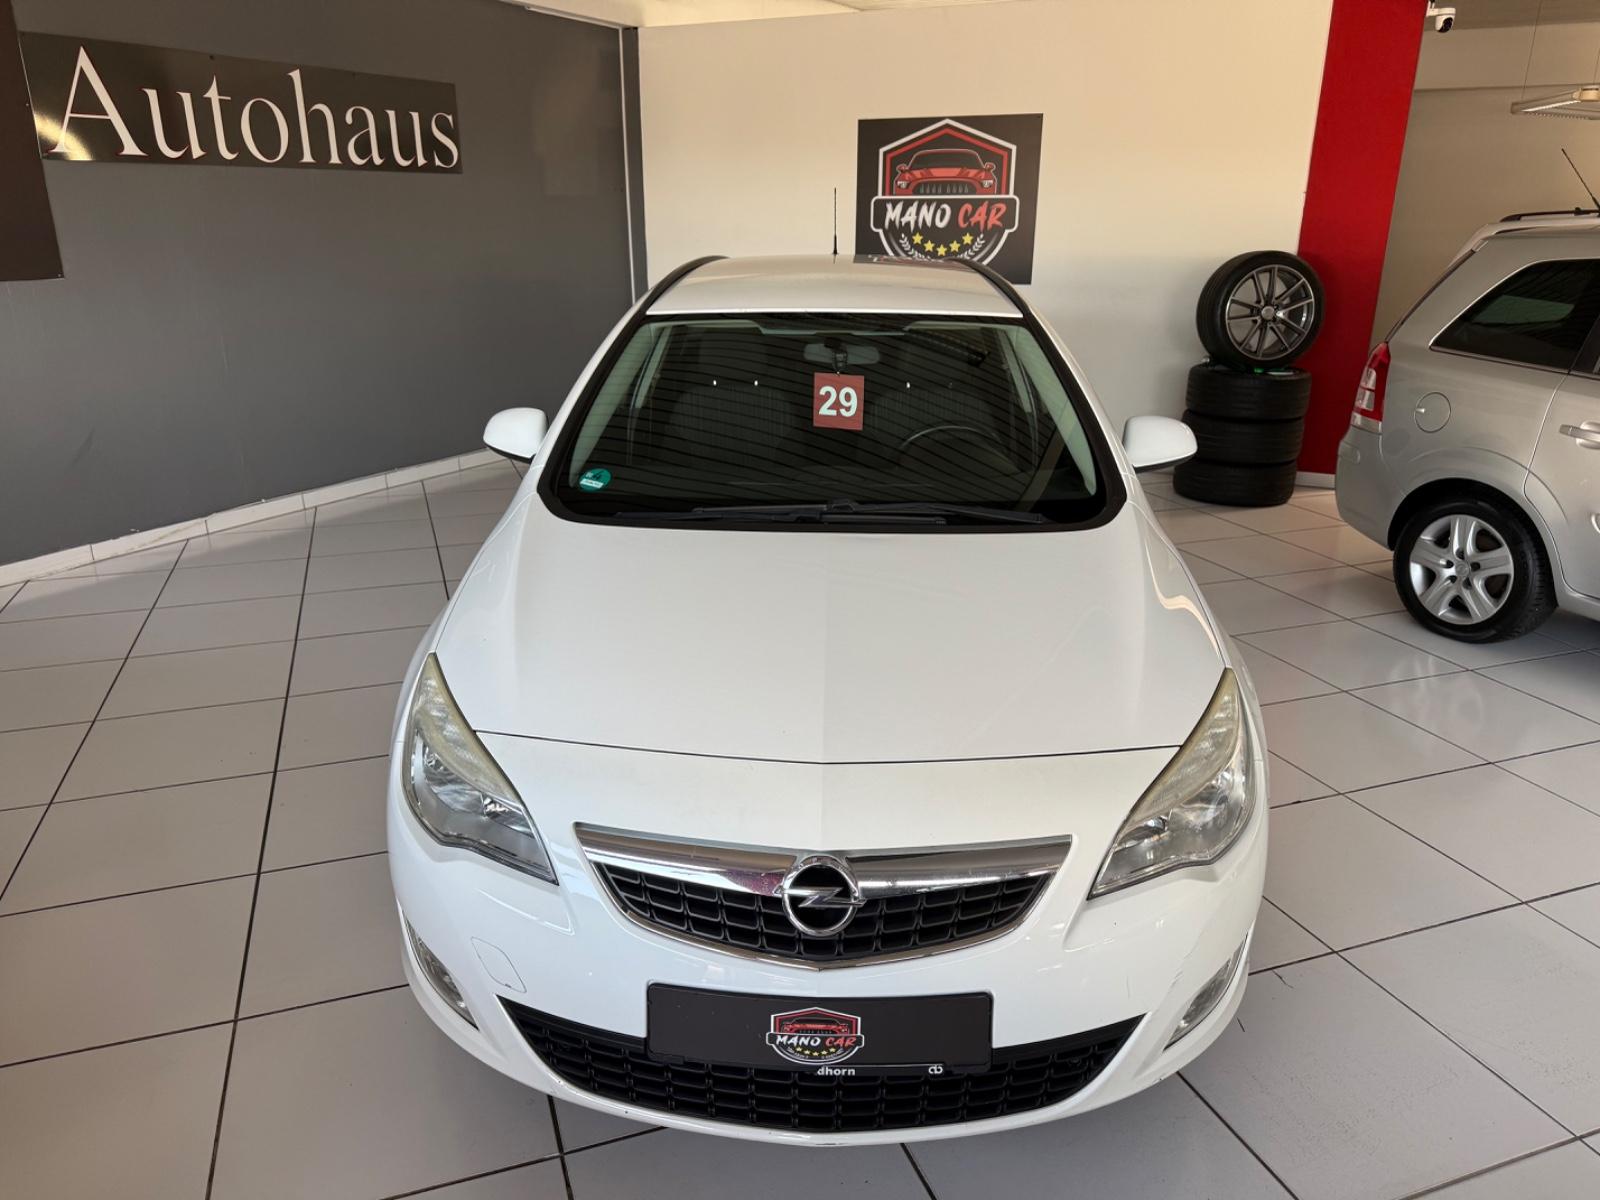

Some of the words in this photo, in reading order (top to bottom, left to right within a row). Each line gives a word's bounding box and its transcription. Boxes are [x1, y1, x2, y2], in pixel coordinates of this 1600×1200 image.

[47, 46, 459, 168] Autohaus
[884, 200, 952, 232] MANO
[957, 201, 1007, 232] CAR
[818, 385, 858, 418] 29
[776, 1034, 821, 1047] MANO
[825, 1036, 857, 1047] CAR
